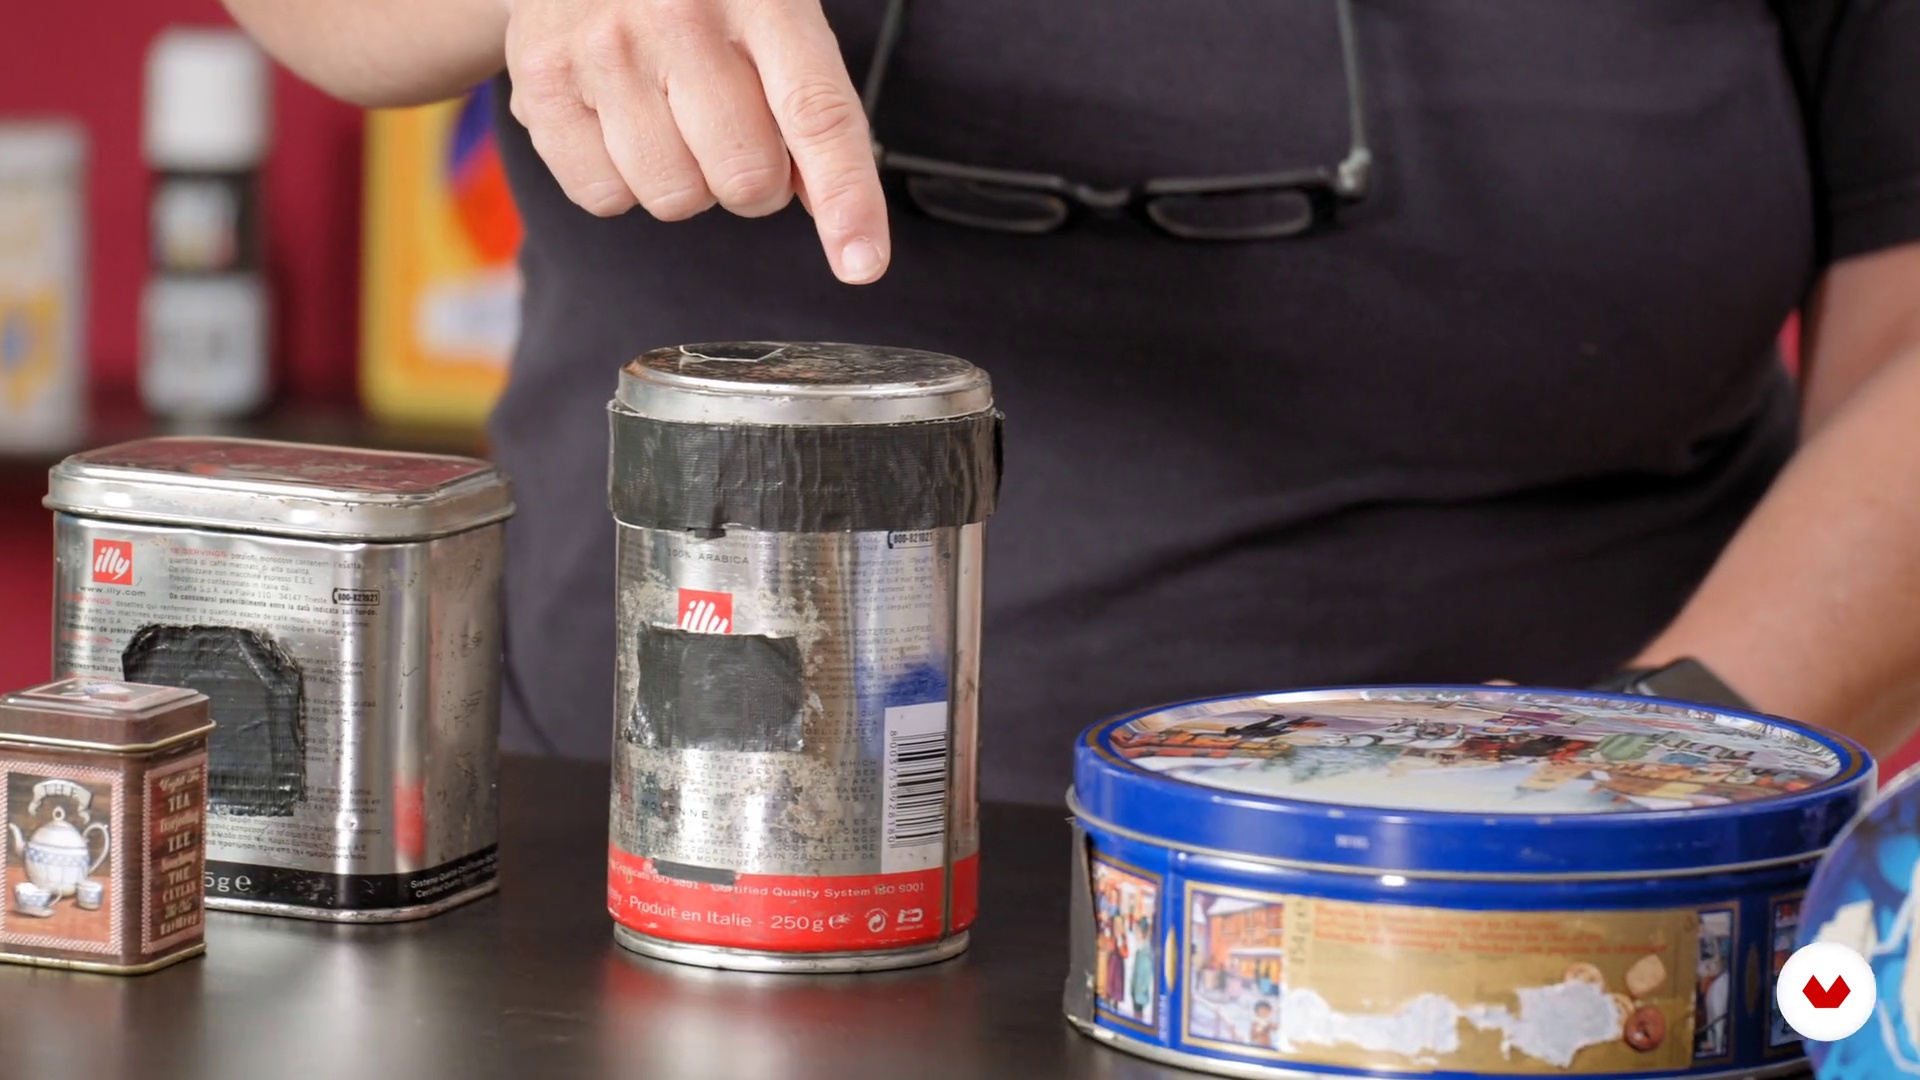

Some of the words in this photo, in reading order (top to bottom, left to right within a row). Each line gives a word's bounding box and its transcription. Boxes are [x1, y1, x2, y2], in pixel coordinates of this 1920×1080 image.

[94, 546, 131, 581] illy
[698, 552, 750, 565] ARABICA
[80, 586, 146, 597] www.illy.com
[167, 792, 191, 813] TEA
[710, 882, 769, 896] Certified
[772, 886, 819, 899] Quality
[824, 887, 871, 899] System
[629, 895, 678, 918] Produit
[681, 910, 702, 922] en
[707, 911, 752, 928] Italie
